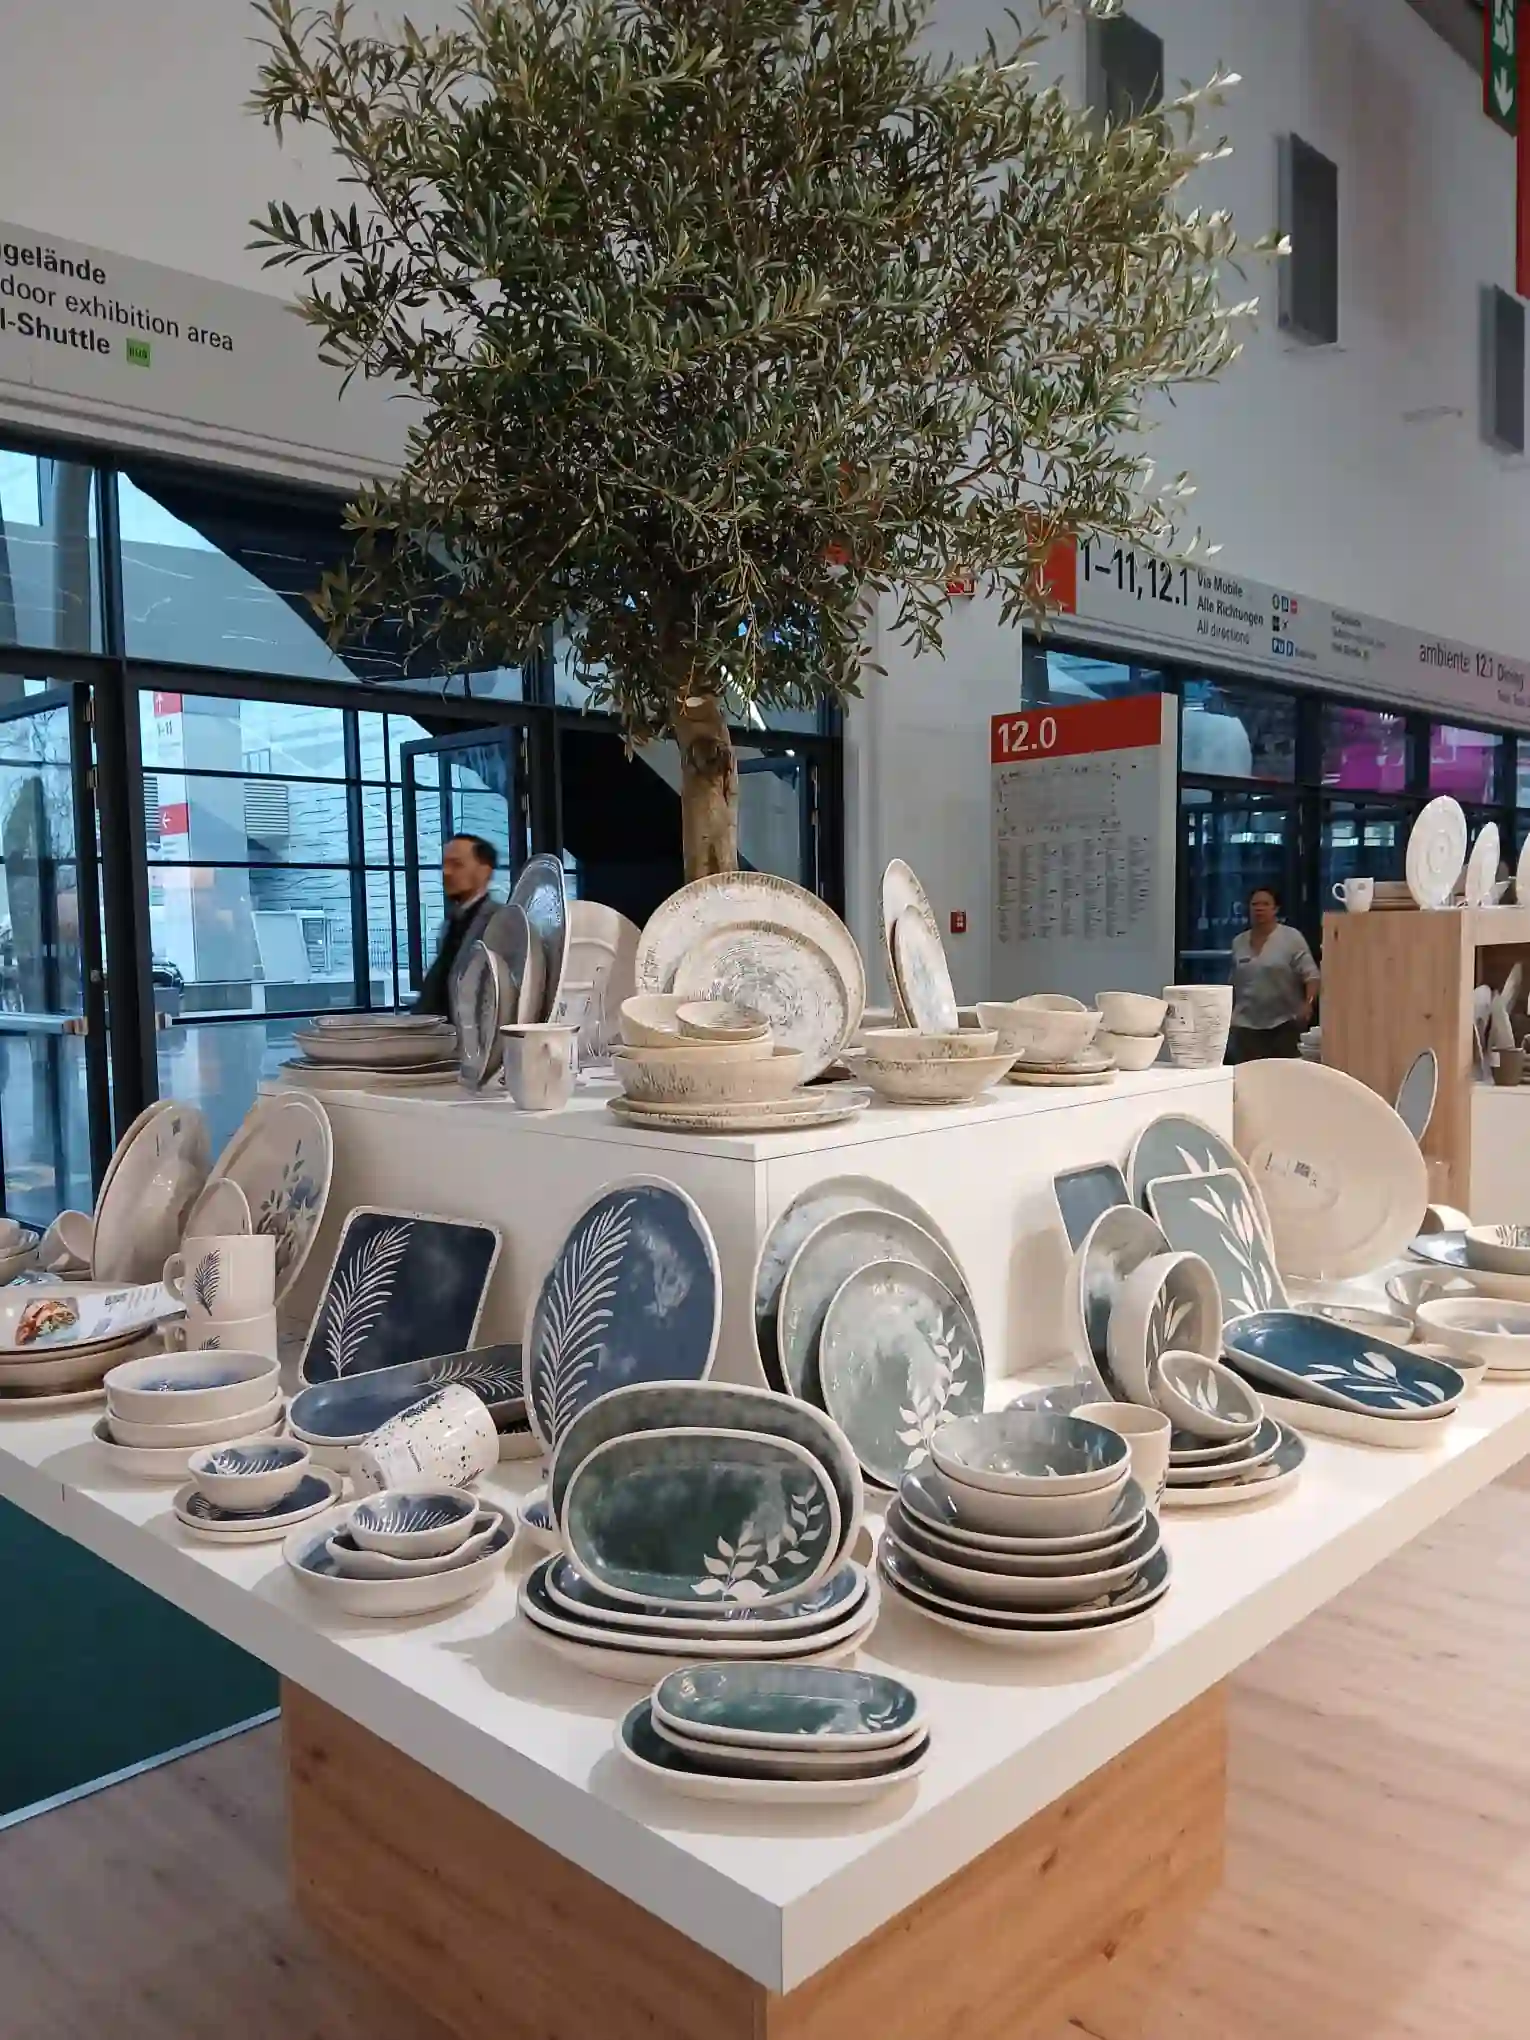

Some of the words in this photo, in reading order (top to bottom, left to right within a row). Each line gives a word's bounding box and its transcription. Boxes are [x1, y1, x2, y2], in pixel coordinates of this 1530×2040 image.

[65, 293, 179, 337] exhibition
[187, 324, 234, 351] area
[1197, 570, 1212, 589] Via
[1213, 576, 1243, 597] Mobile
[1197, 595, 1214, 612] Alle
[1216, 599, 1264, 626] Richtungen
[1197, 619, 1209, 635] All
[1210, 623, 1250, 645] directions
[1419, 642, 1470, 673] ambiente
[997, 715, 1058, 754] 12.0
